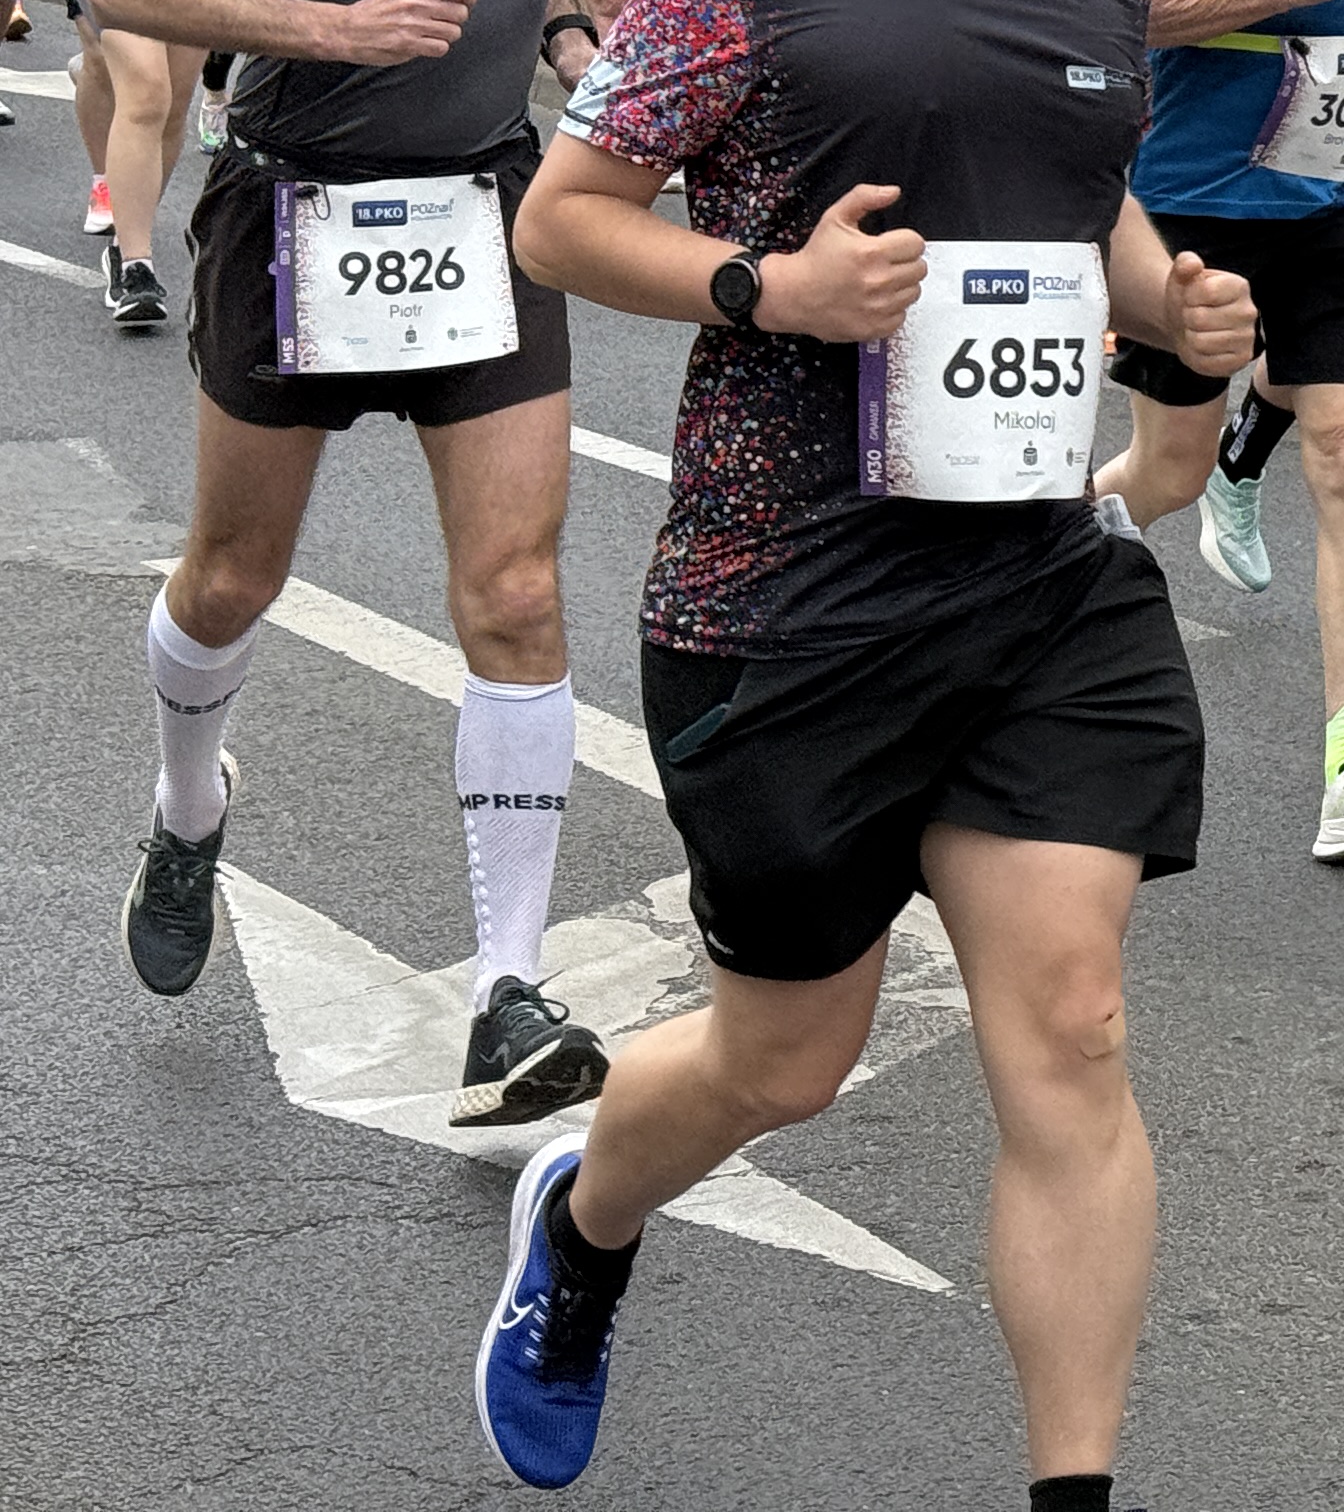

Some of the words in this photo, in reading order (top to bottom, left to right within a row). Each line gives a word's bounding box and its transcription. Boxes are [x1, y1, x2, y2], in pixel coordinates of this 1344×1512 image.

[338, 246, 466, 296] 9826
[390, 304, 424, 319] Piotr
[943, 337, 1086, 399] 6853
[867, 448, 882, 483] M30
